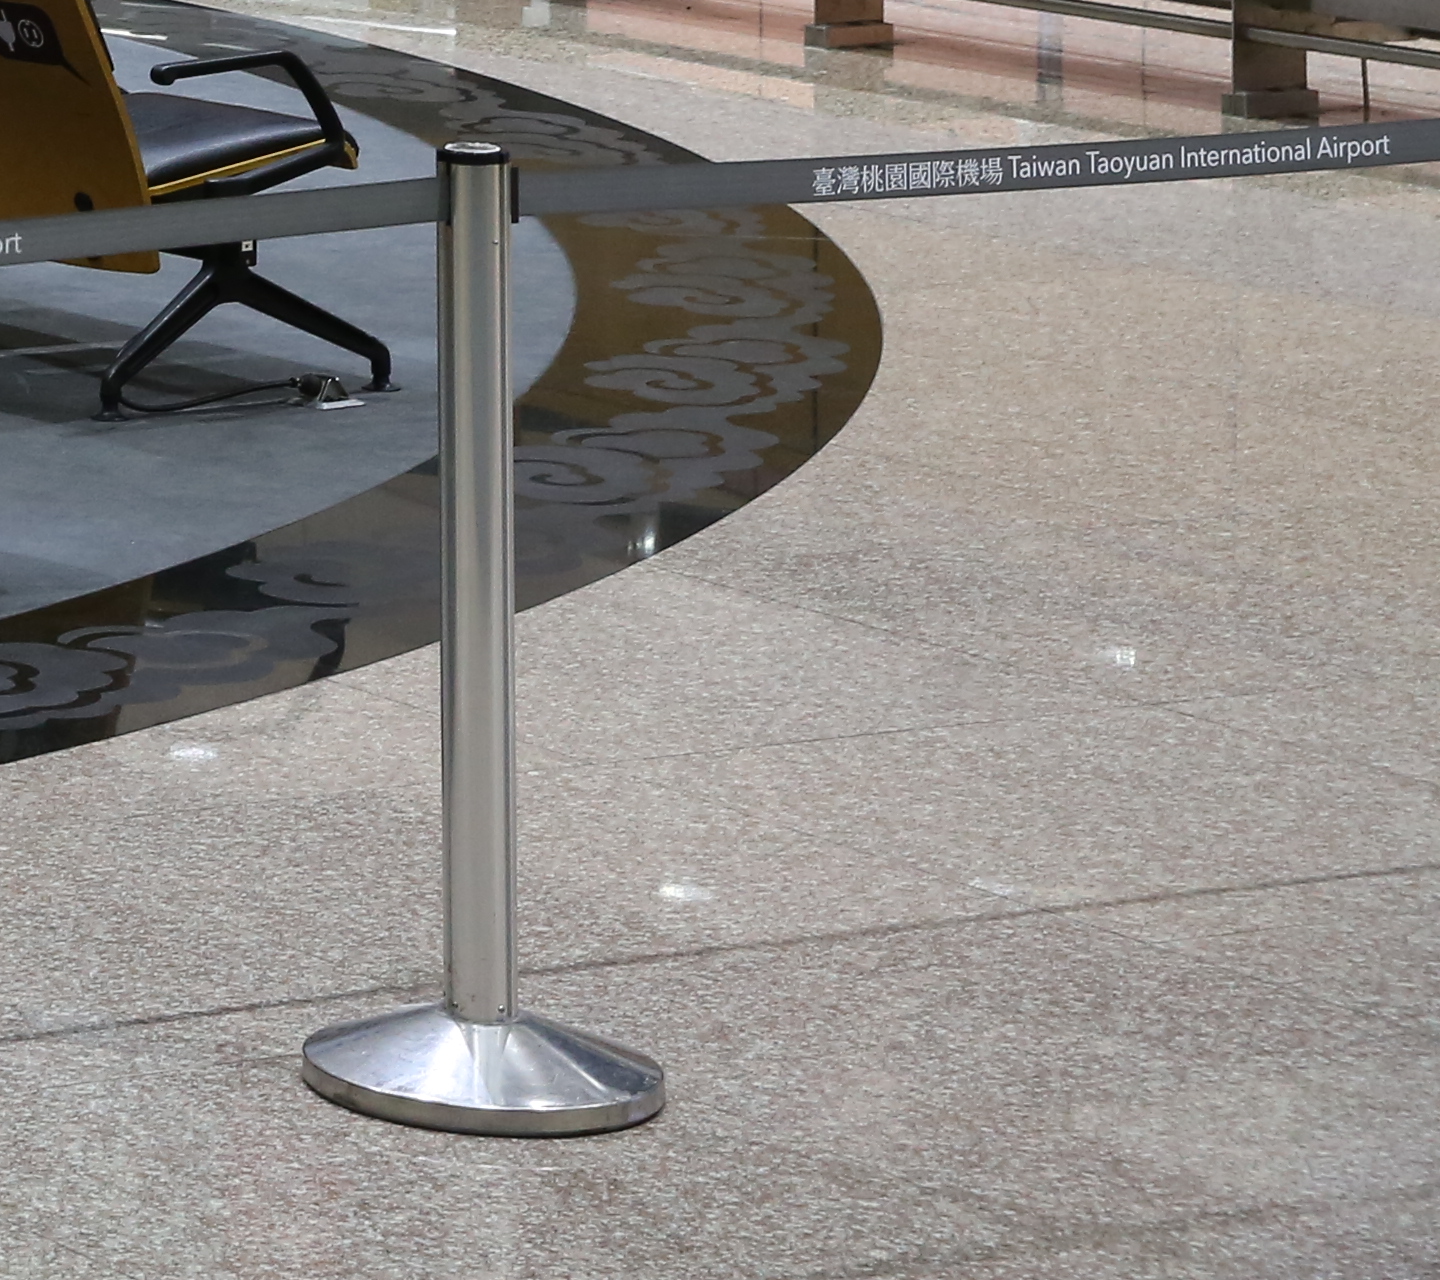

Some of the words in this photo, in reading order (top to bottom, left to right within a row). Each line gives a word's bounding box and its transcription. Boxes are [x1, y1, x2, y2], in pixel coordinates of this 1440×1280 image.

[812, 154, 1004, 197] 臺灣桃園國際機場
[1008, 153, 1080, 180] Taiwan
[1085, 148, 1174, 180] Taoyuan
[1180, 137, 1312, 169] International
[1317, 133, 1391, 162] Airport
